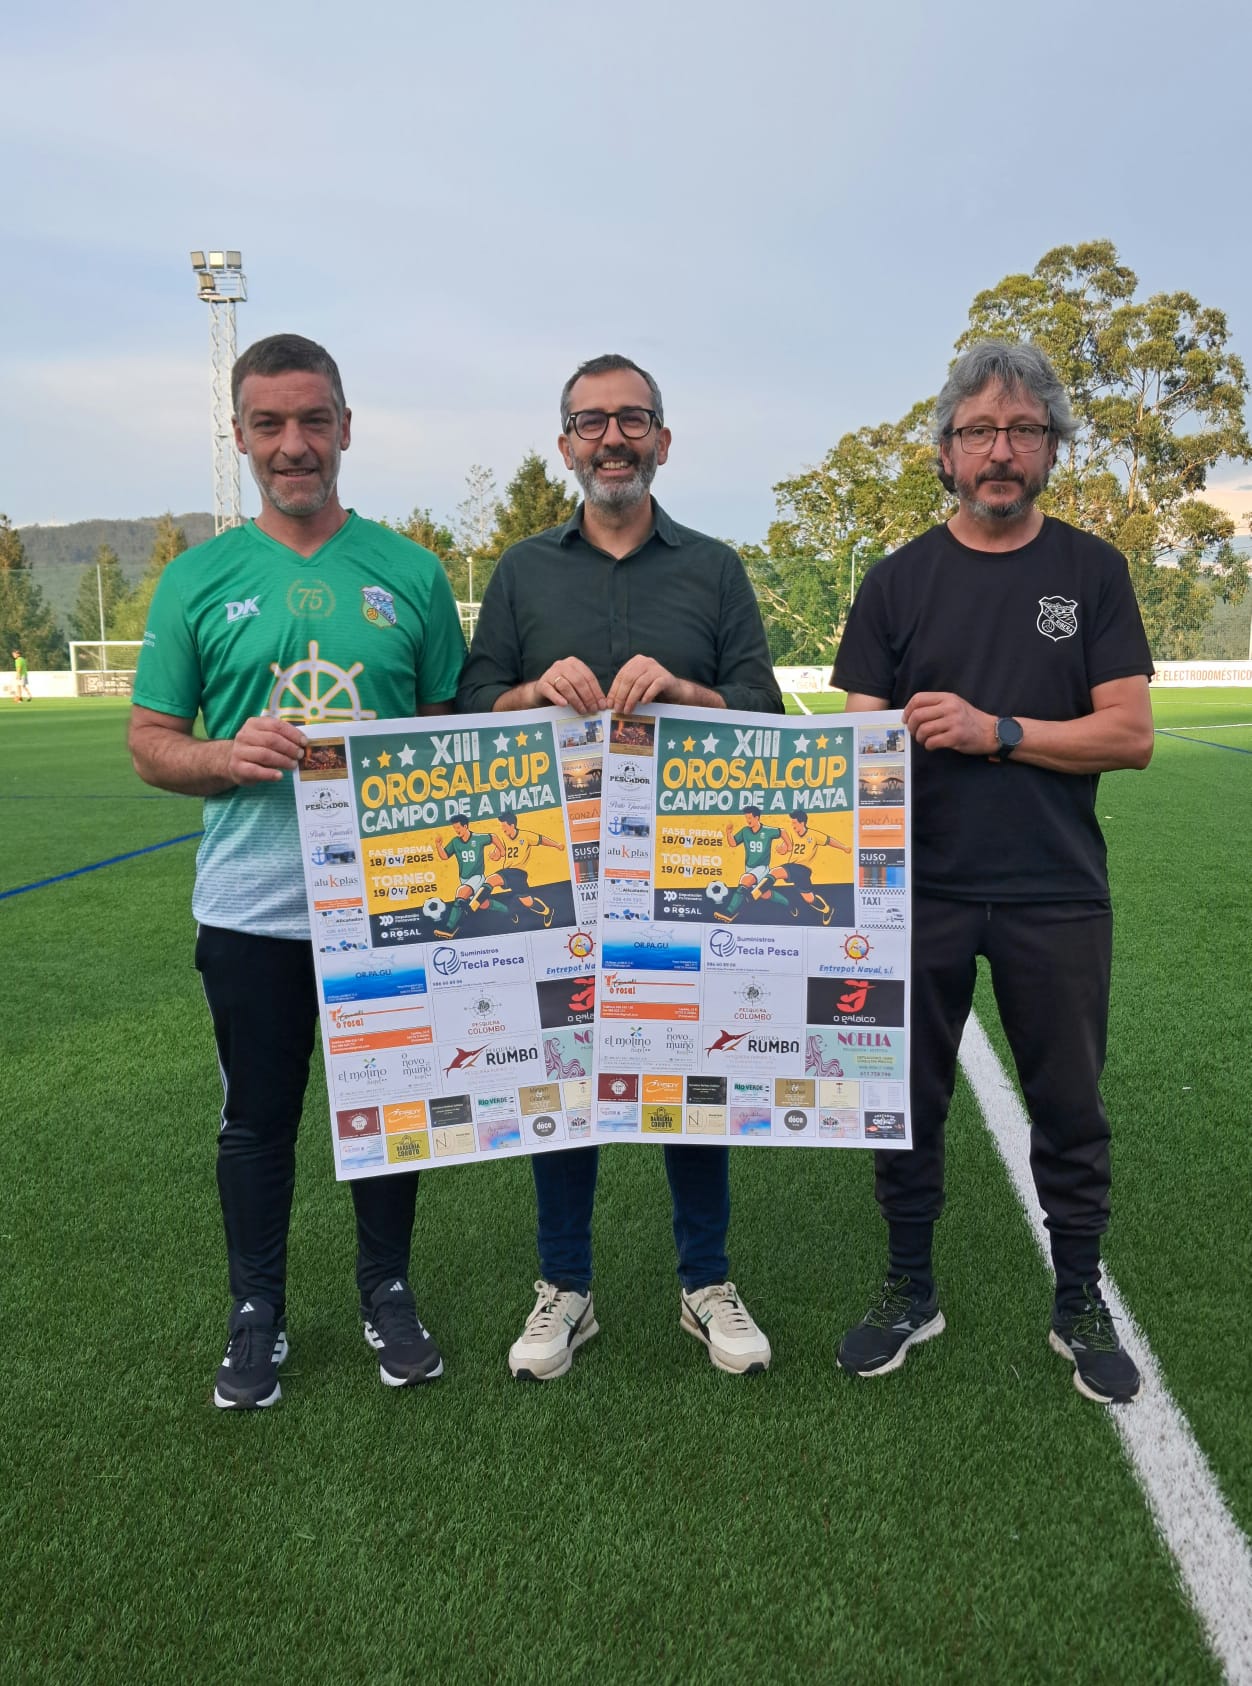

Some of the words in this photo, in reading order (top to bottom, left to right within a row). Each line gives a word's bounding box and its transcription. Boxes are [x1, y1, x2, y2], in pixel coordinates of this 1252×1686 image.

[297, 588, 322, 611] 75
[224, 595, 260, 621] DK
[1056, 620, 1073, 632] RIBERA
[430, 732, 480, 765] XIII
[732, 729, 780, 758] XIII
[662, 756, 846, 790] OROSALCUP
[361, 751, 550, 809] OROSALCUP
[610, 776, 650, 784] PESCADOR
[659, 790, 733, 811] CAMPO
[739, 790, 764, 810] DE
[770, 791, 786, 810] A
[793, 788, 848, 810] MATA
[306, 802, 349, 811] PESCADOR
[361, 802, 438, 833] CAMPO
[445, 797, 472, 821] DE
[478, 794, 494, 816] A
[500, 784, 556, 812] MATA
[662, 828, 685, 836] FASE
[689, 828, 723, 838] PREVIA
[662, 836, 722, 846] 18/04/2025
[750, 841, 762, 852] 99
[368, 847, 392, 858] FASE
[396, 844, 434, 855] PREVIA
[508, 847, 518, 858] 22
[574, 846, 598, 856] SUSO
[794, 844, 805, 854] 22
[370, 854, 434, 866] 18/04/2025
[462, 850, 476, 862] 99
[661, 853, 722, 866] TORNEO
[661, 866, 722, 876] 19/04/2025
[372, 872, 436, 888] TORNEO
[374, 884, 438, 898] 19/04/2025
[862, 897, 880, 906] TAXI
[390, 928, 422, 938] ROSAL
[460, 948, 498, 956] Suministros
[738, 946, 764, 954] Tecla
[768, 947, 799, 956] Pesca
[462, 960, 489, 970] Tecla
[492, 956, 524, 966] Pesca
[546, 964, 582, 975] Entrepot
[819, 964, 855, 974] Entrepot
[616, 986, 636, 994] rosal
[734, 1012, 772, 1020] COLOMBO
[842, 1014, 876, 1024] galaico
[343, 1018, 364, 1028] rosal
[468, 1025, 506, 1035] COLOMBO
[616, 1037, 651, 1048] molino
[838, 1032, 892, 1047] NOELIA
[748, 1040, 800, 1053] RUMBO
[402, 1058, 424, 1067] novo
[486, 1048, 538, 1066] RUMBO
[350, 1068, 386, 1081] molino
